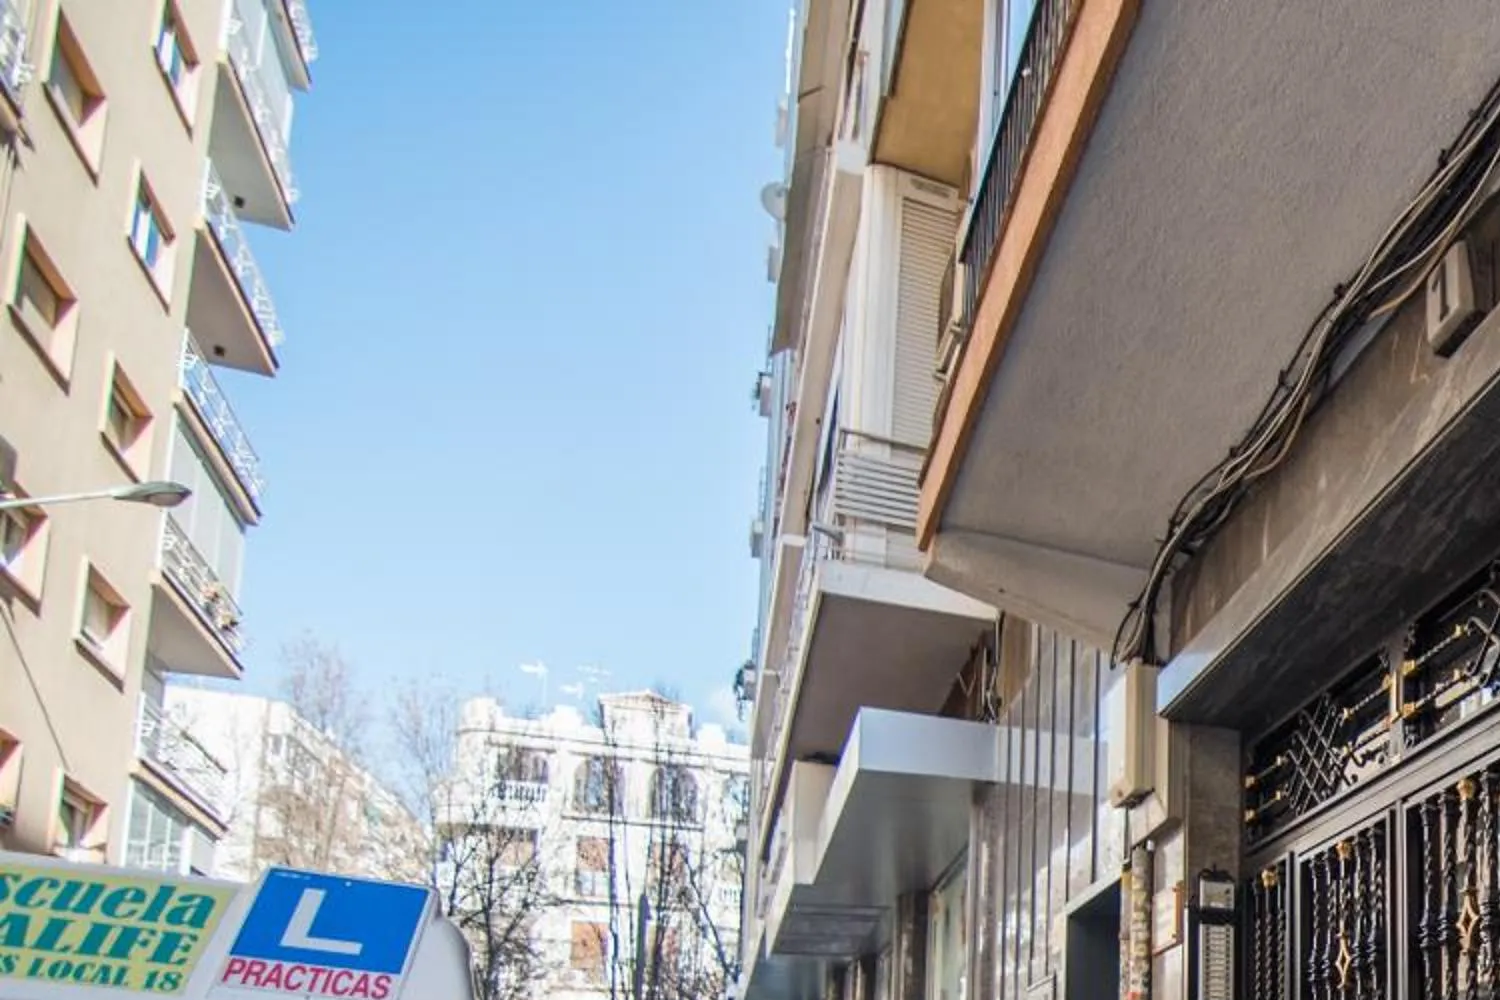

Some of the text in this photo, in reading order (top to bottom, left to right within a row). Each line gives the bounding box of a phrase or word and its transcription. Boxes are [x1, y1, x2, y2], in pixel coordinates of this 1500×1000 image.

[280, 887, 363, 955] L
[27, 957, 129, 987] LOCAL
[143, 969, 183, 992] 18
[221, 957, 392, 1000] PRACTICAS
